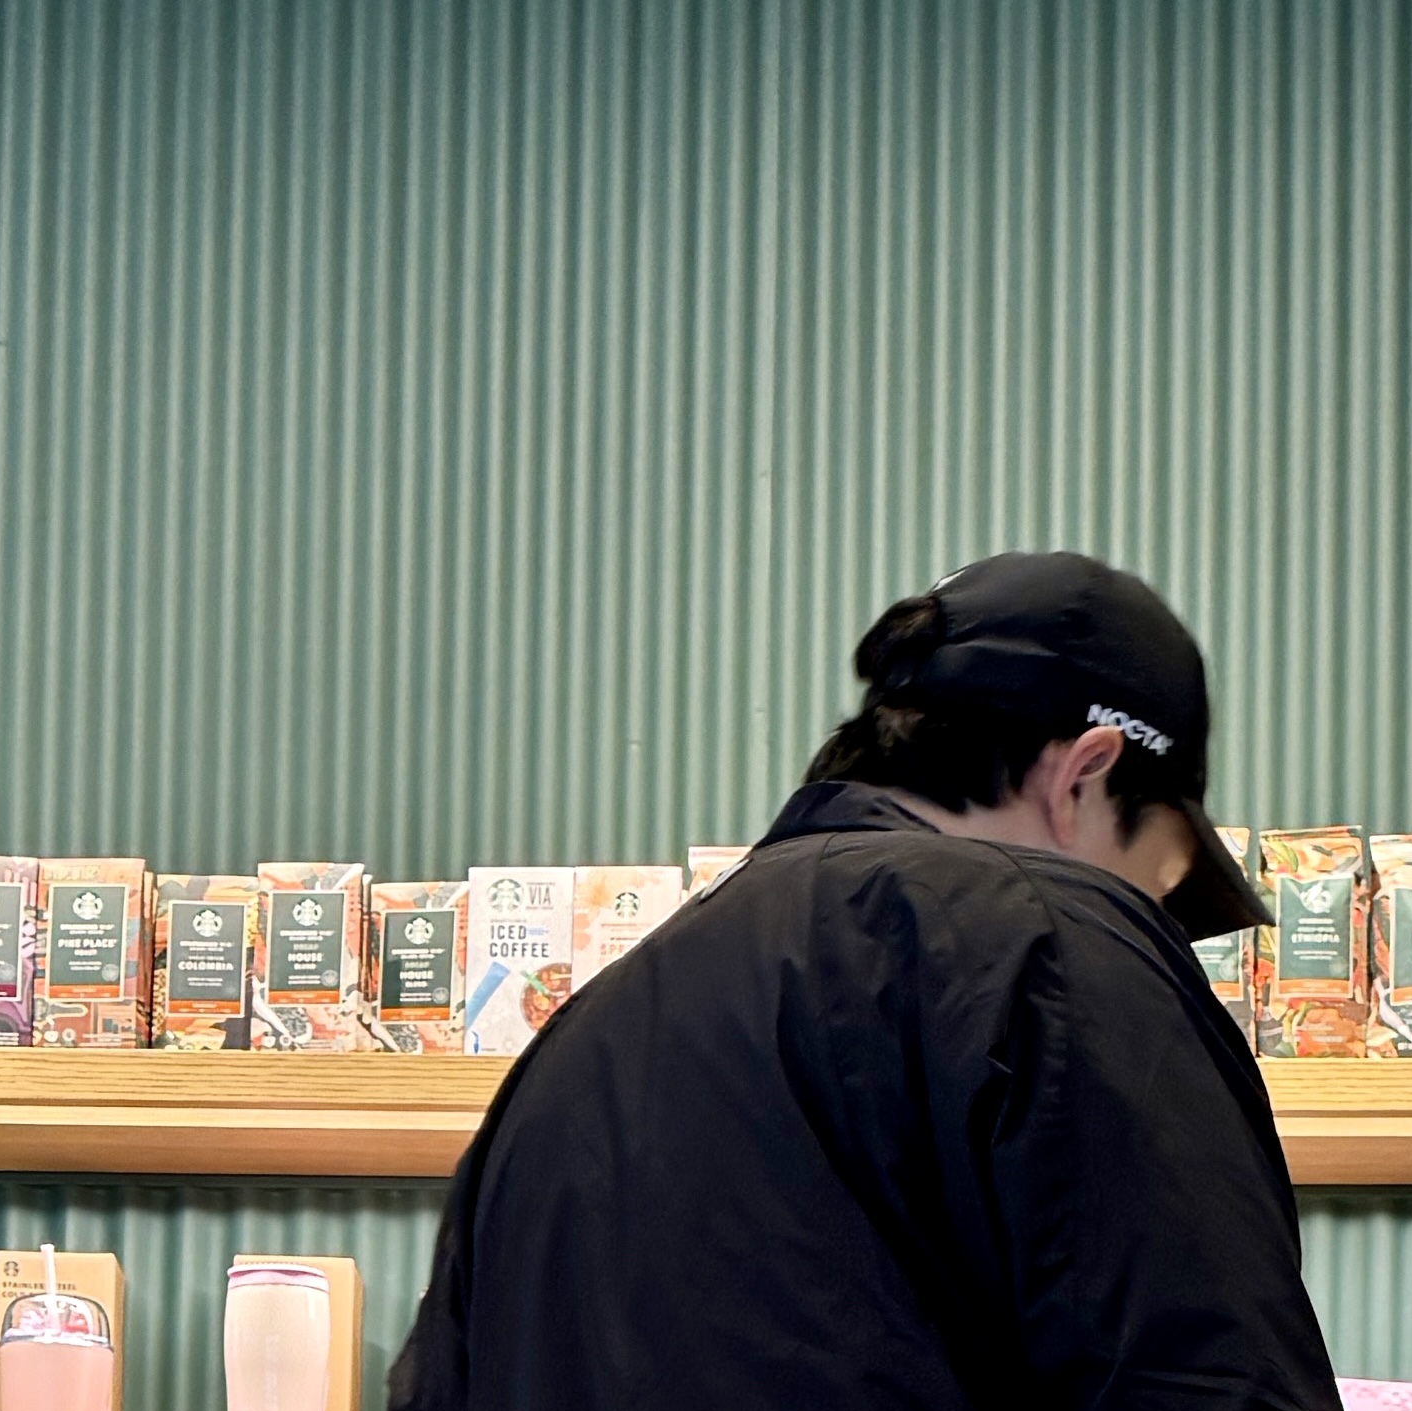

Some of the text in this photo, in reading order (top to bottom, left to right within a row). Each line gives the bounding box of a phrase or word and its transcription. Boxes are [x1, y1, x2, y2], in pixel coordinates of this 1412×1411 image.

[1087, 703, 1175, 756] NOCTA
[529, 886, 552, 905] VIA
[490, 925, 527, 940] ICED
[489, 943, 549, 958] COFFEE
[2, 1281, 45, 1290] STAINLES
